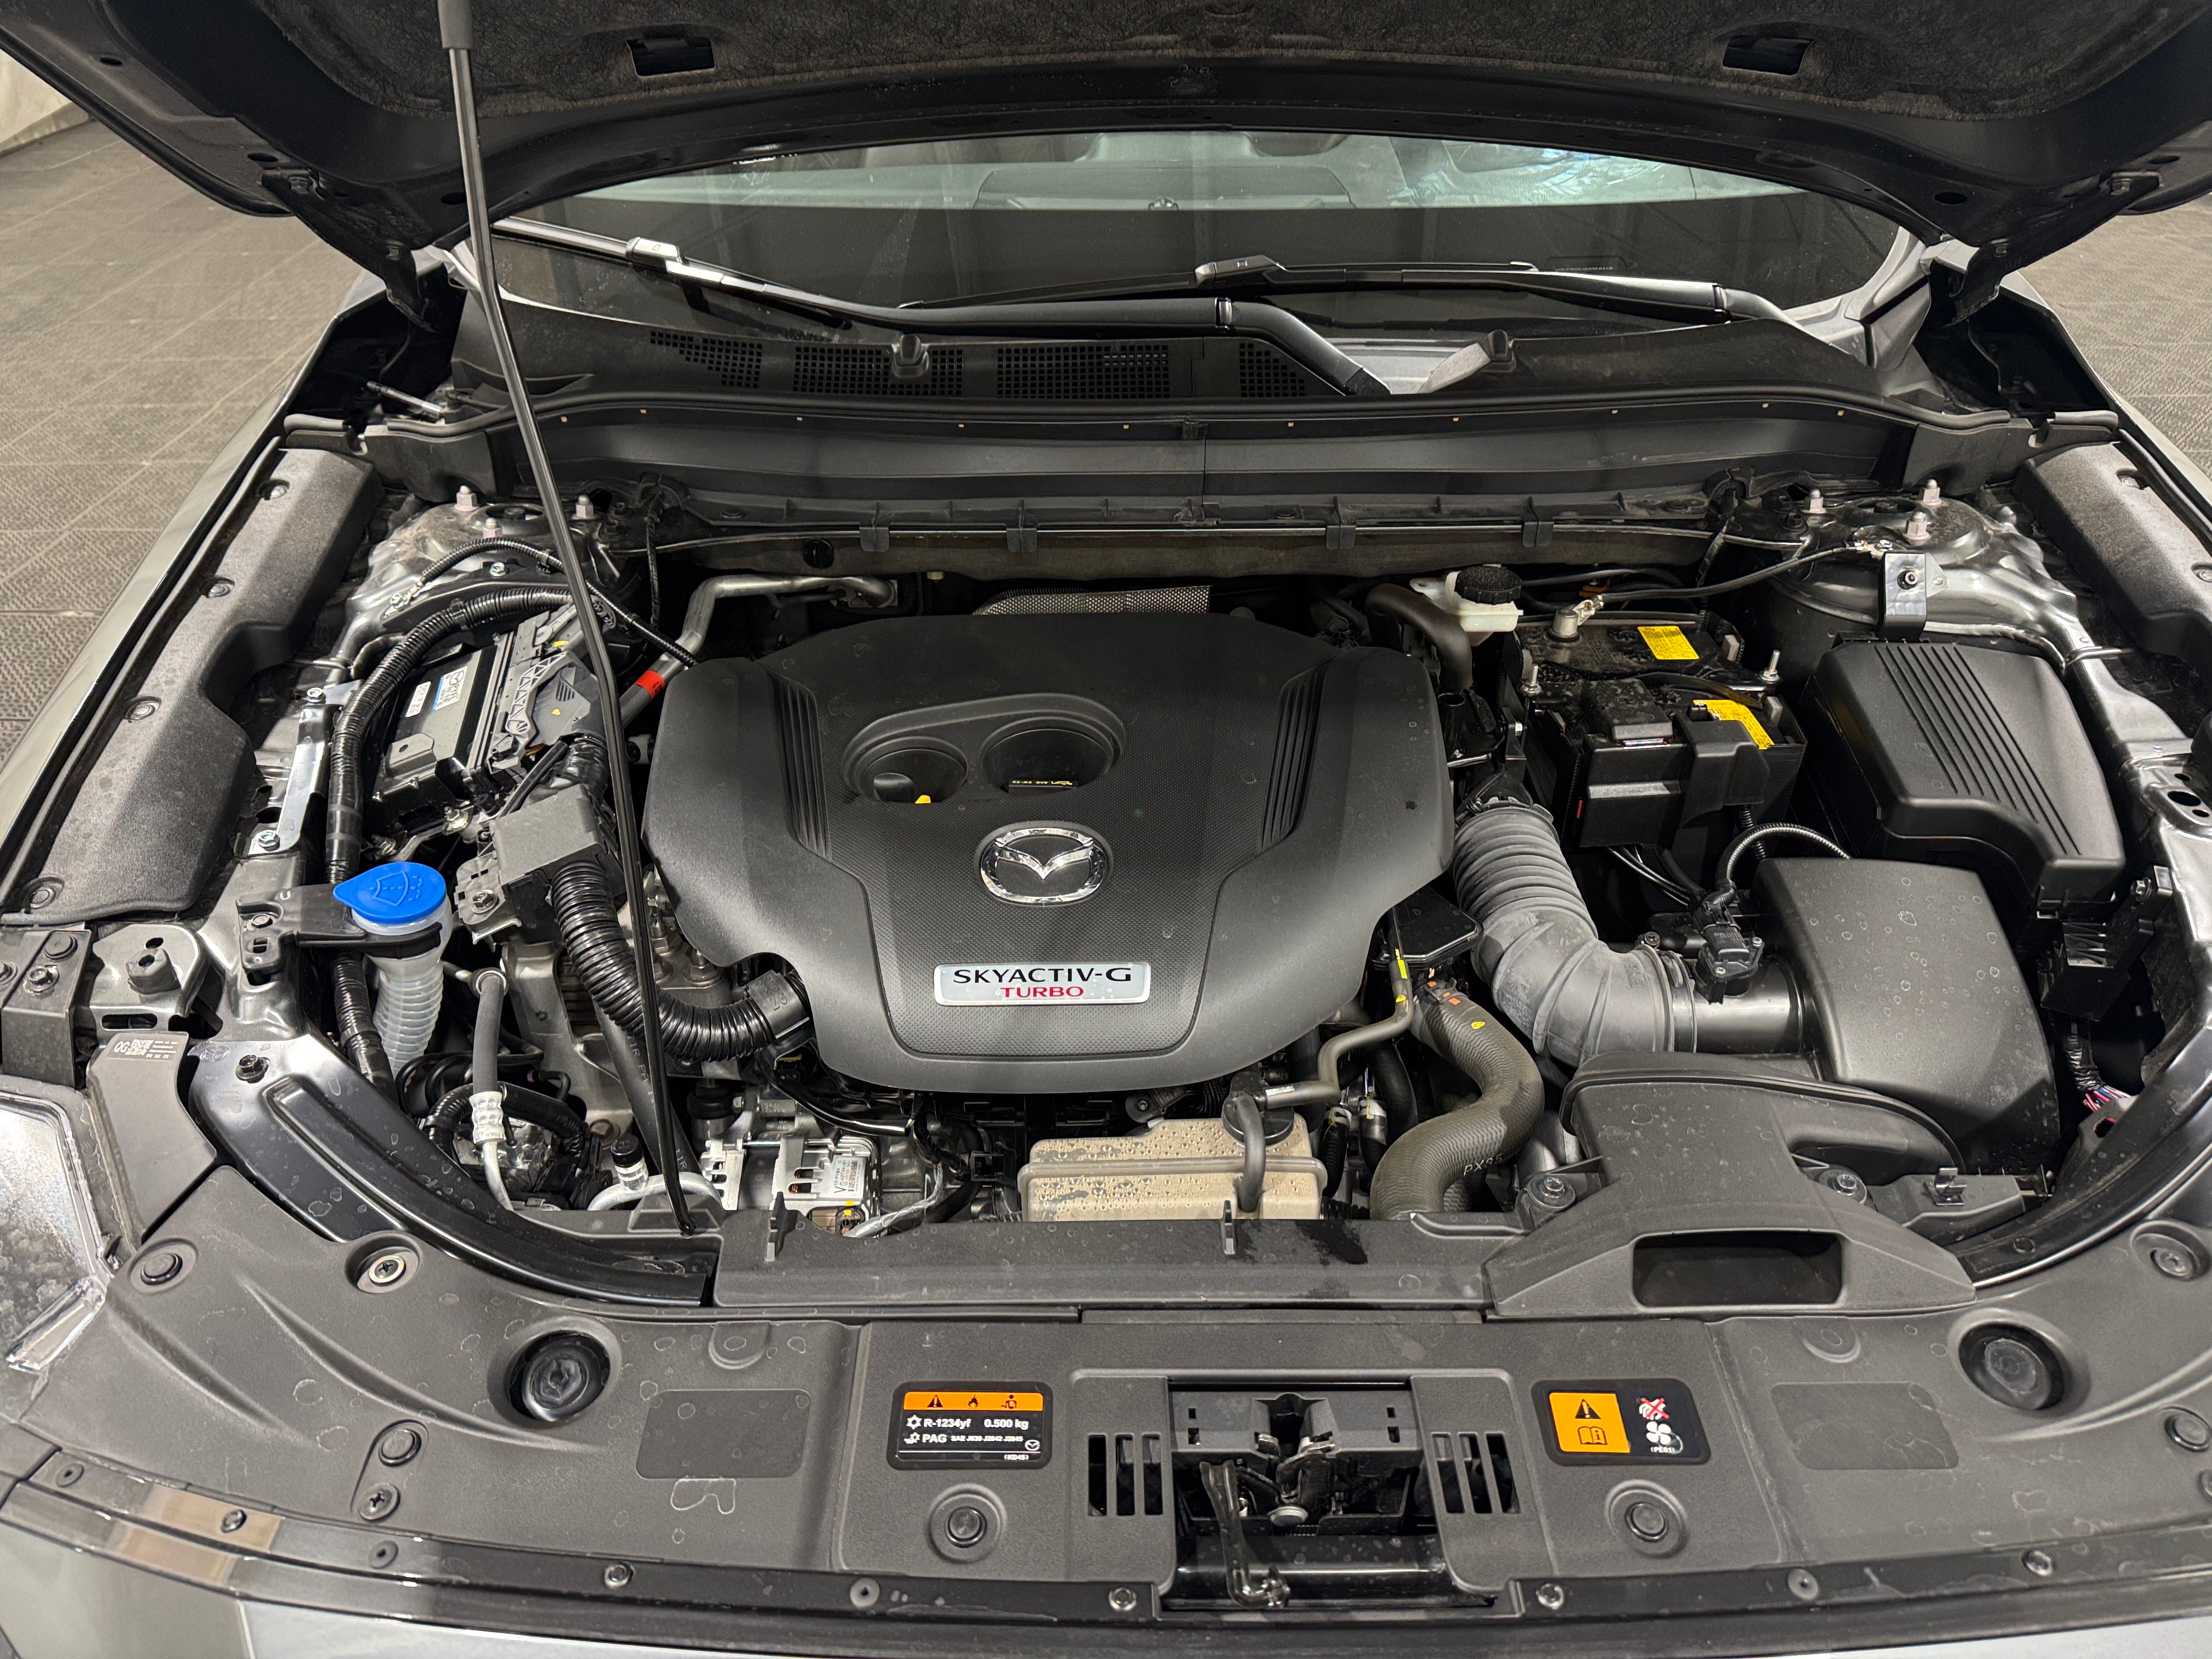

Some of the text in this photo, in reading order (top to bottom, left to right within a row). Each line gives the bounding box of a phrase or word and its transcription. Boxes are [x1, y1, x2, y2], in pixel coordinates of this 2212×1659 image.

[953, 968, 1131, 984] SKYACTIV-G
[1000, 986, 1084, 998] TURBO
[924, 1418, 1029, 1430] R-1234yf 0.500 kg
[922, 1434, 947, 1443] PAG
